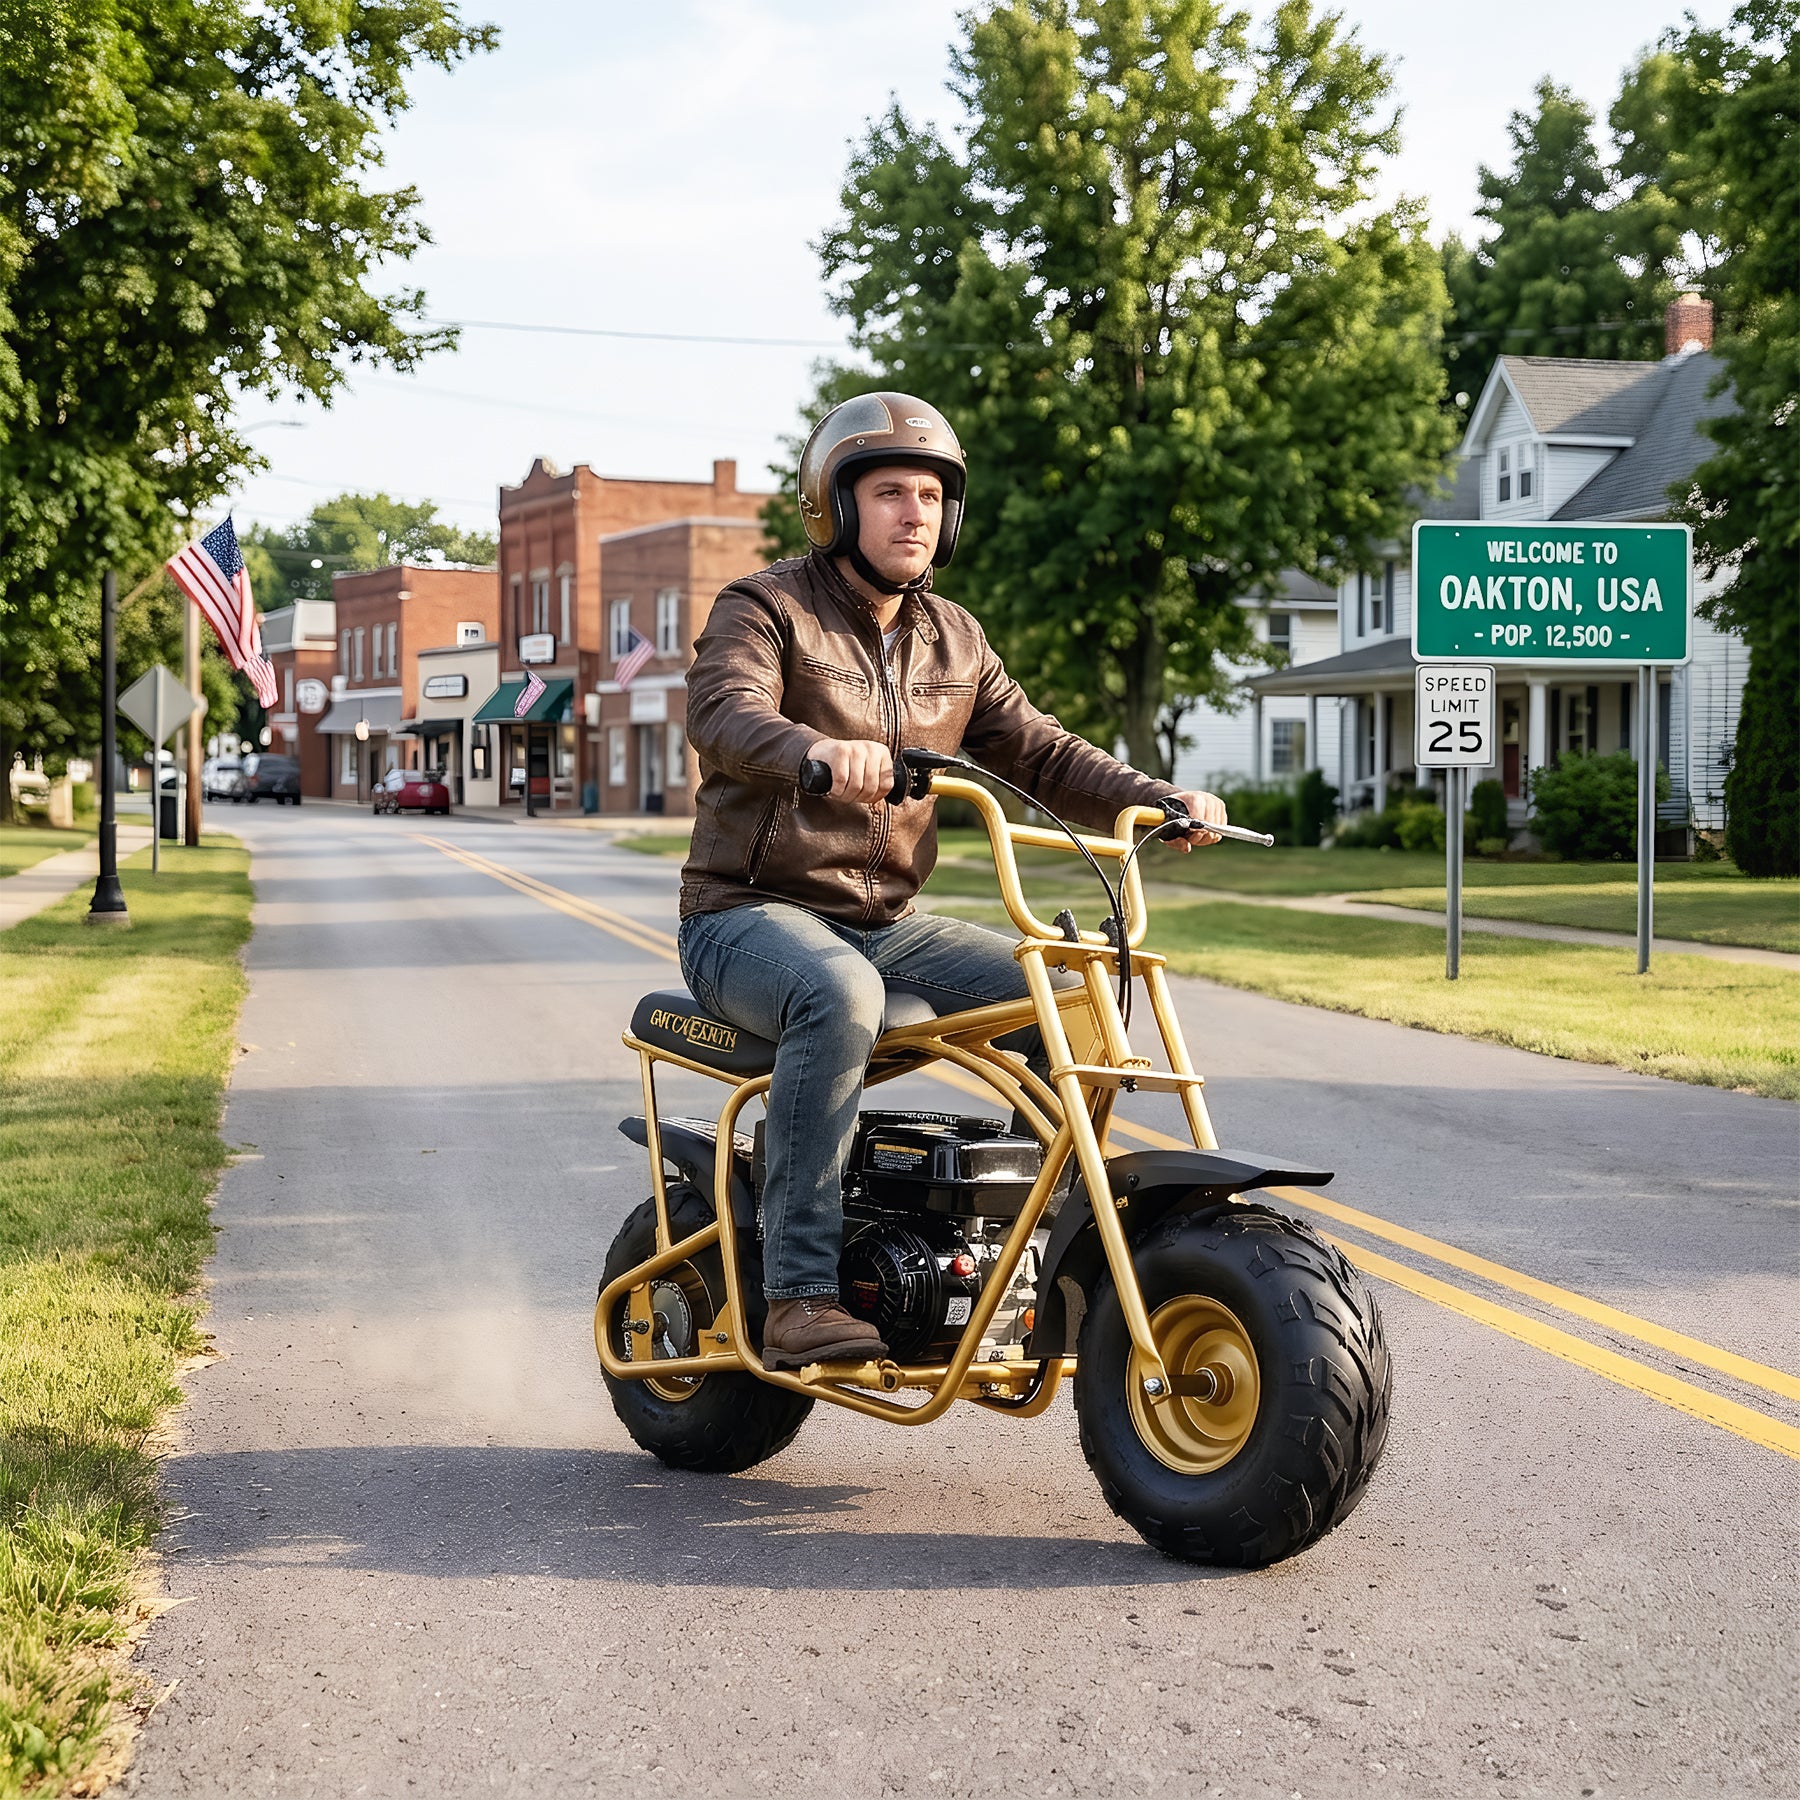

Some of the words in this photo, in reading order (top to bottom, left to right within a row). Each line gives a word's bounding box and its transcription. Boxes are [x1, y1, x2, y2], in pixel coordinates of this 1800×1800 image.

[1487, 541, 1584, 564] WELCOME
[1592, 542, 1618, 564] TO
[1440, 575, 1583, 616] OAKTON,
[1597, 577, 1664, 612] USA
[1491, 624, 1537, 646] POP.
[1546, 625, 1613, 649] 12,500
[1425, 677, 1487, 692] SPEED
[1431, 699, 1480, 713] LIMIT
[1428, 720, 1483, 753] 25
